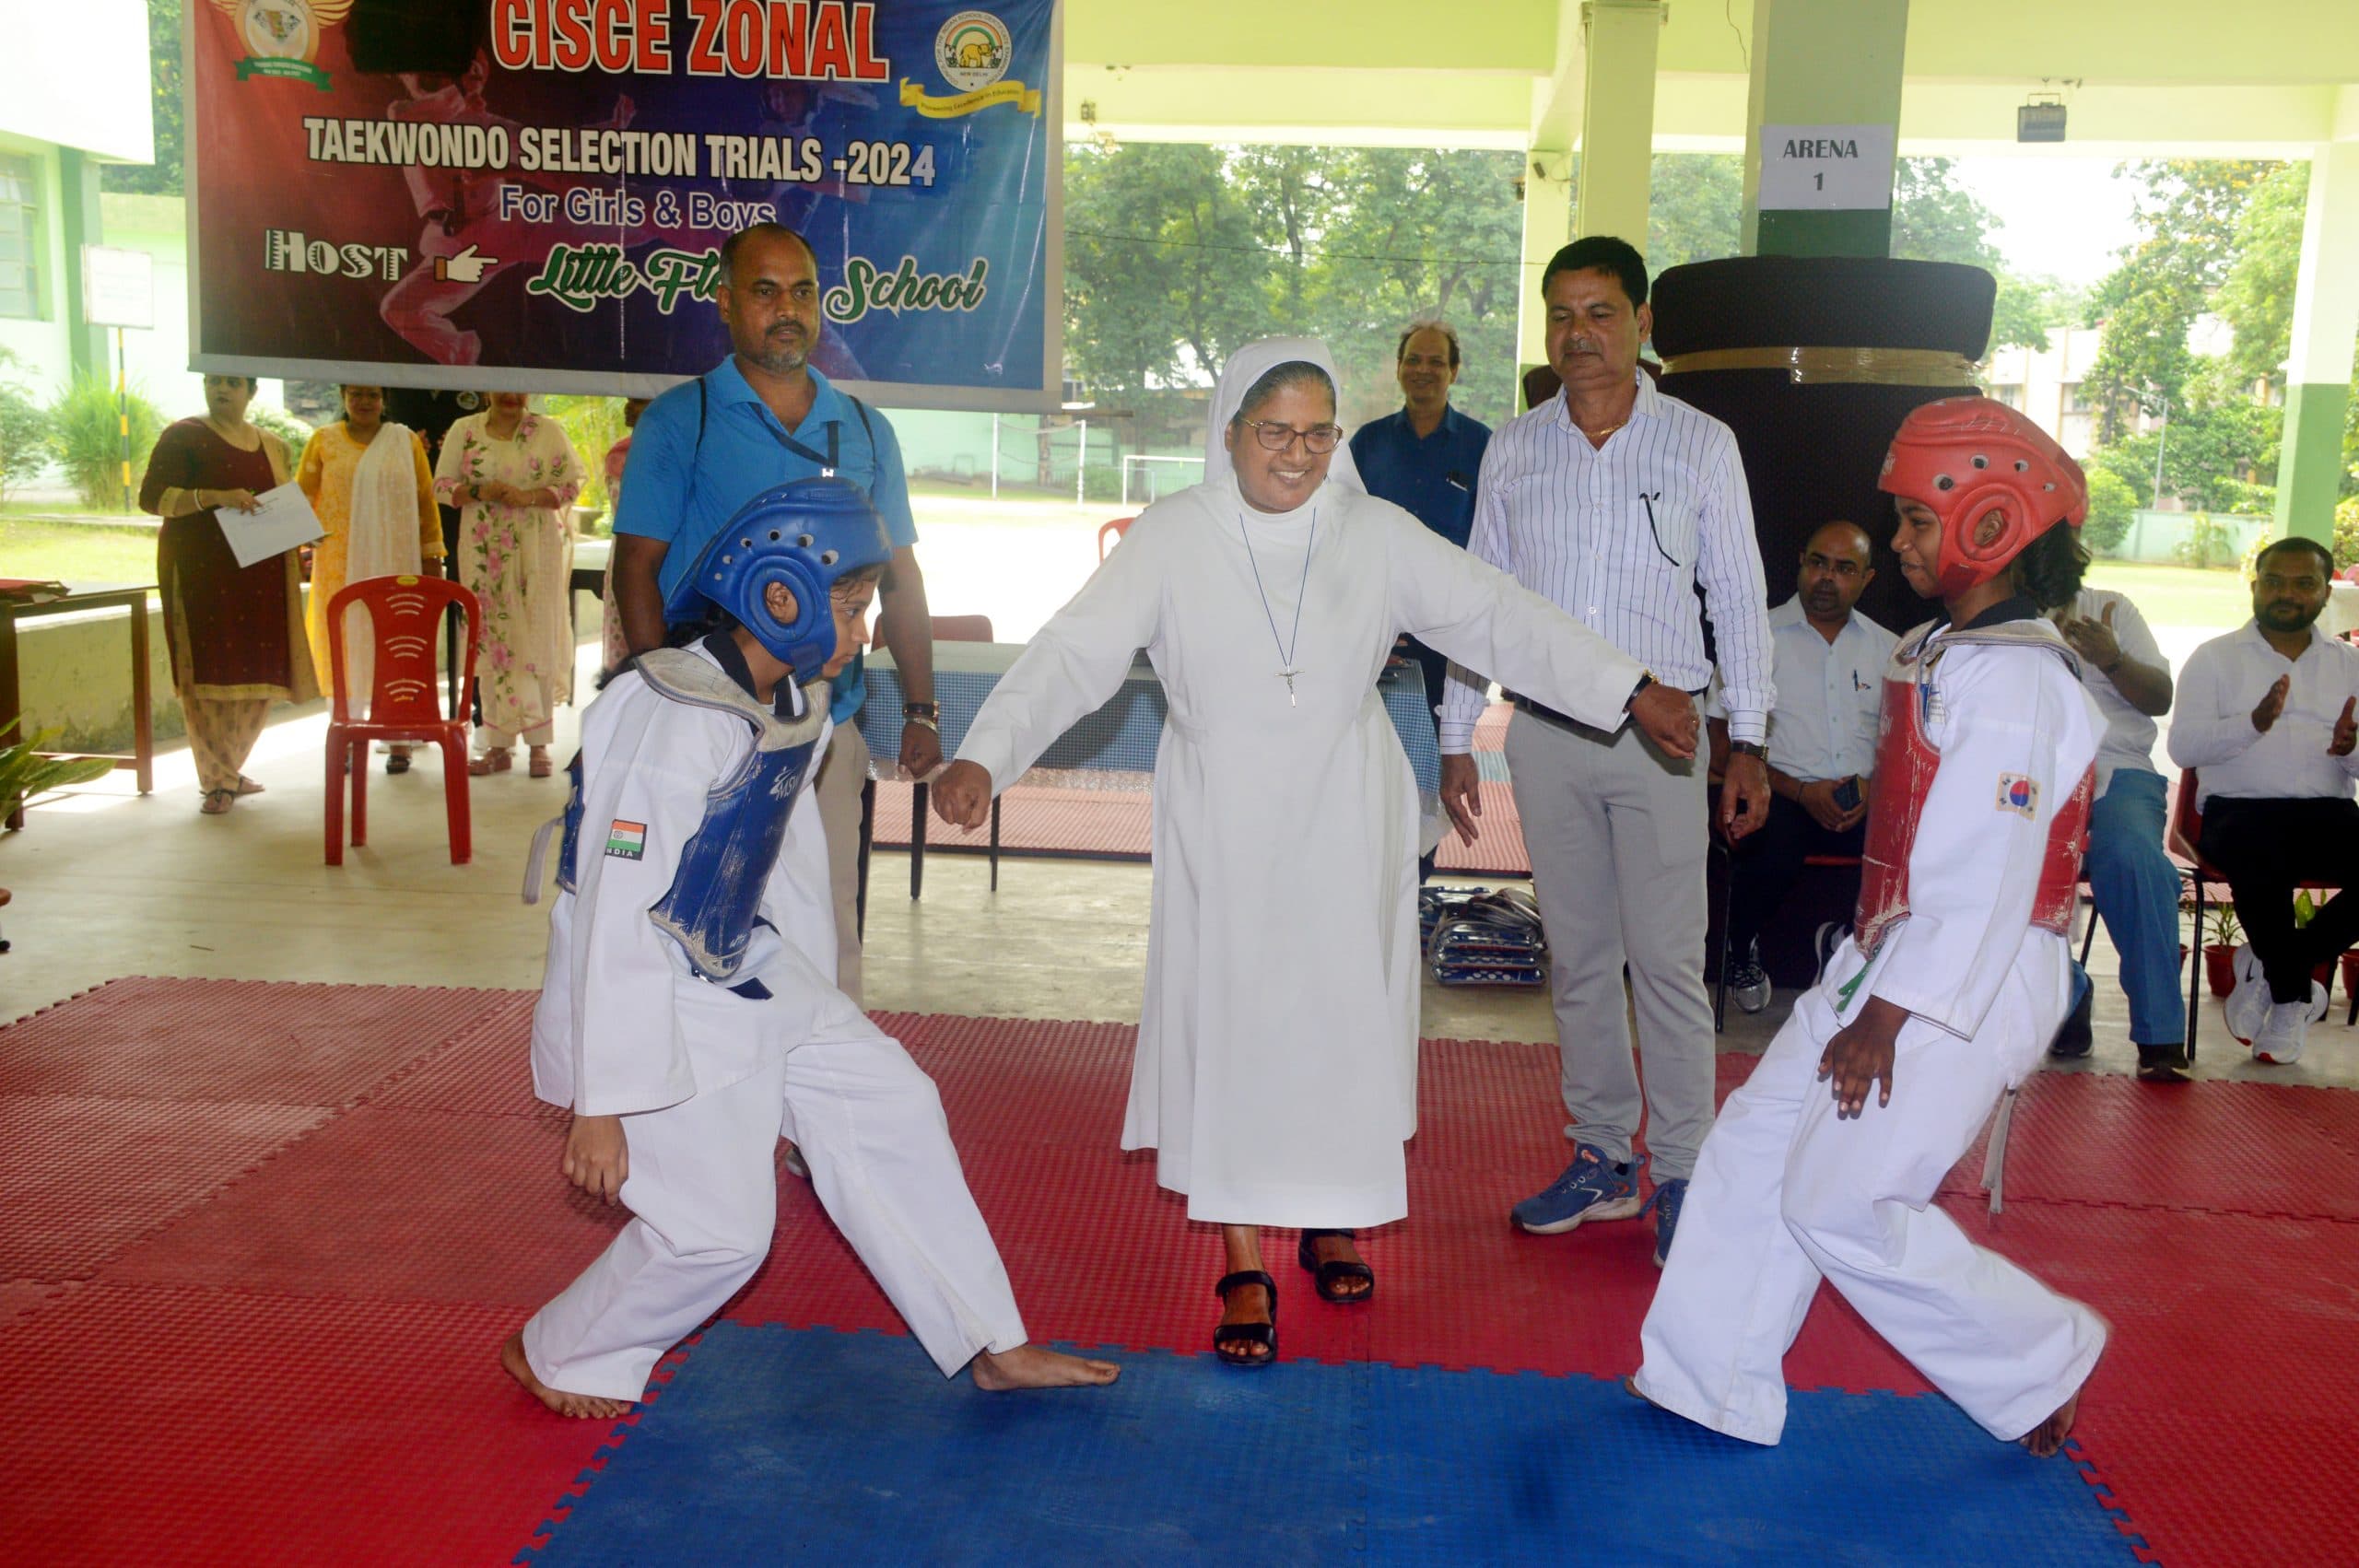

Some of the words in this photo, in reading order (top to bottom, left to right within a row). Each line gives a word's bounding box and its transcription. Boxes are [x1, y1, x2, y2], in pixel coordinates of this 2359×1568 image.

[491, 0, 672, 74] CISCE
[687, 0, 890, 83] ZONAL
[303, 116, 510, 170] TAEKWONDO
[519, 126, 697, 177] SELECTION
[704, 135, 823, 182] TRIALS
[1783, 139, 1859, 158] ARENA
[500, 184, 559, 223] For
[564, 186, 645, 227] Girls
[652, 190, 682, 229] &
[689, 192, 777, 233] Boys
[1813, 172, 1824, 191] 1
[525, 242, 643, 313] Little
[822, 254, 989, 324] School
